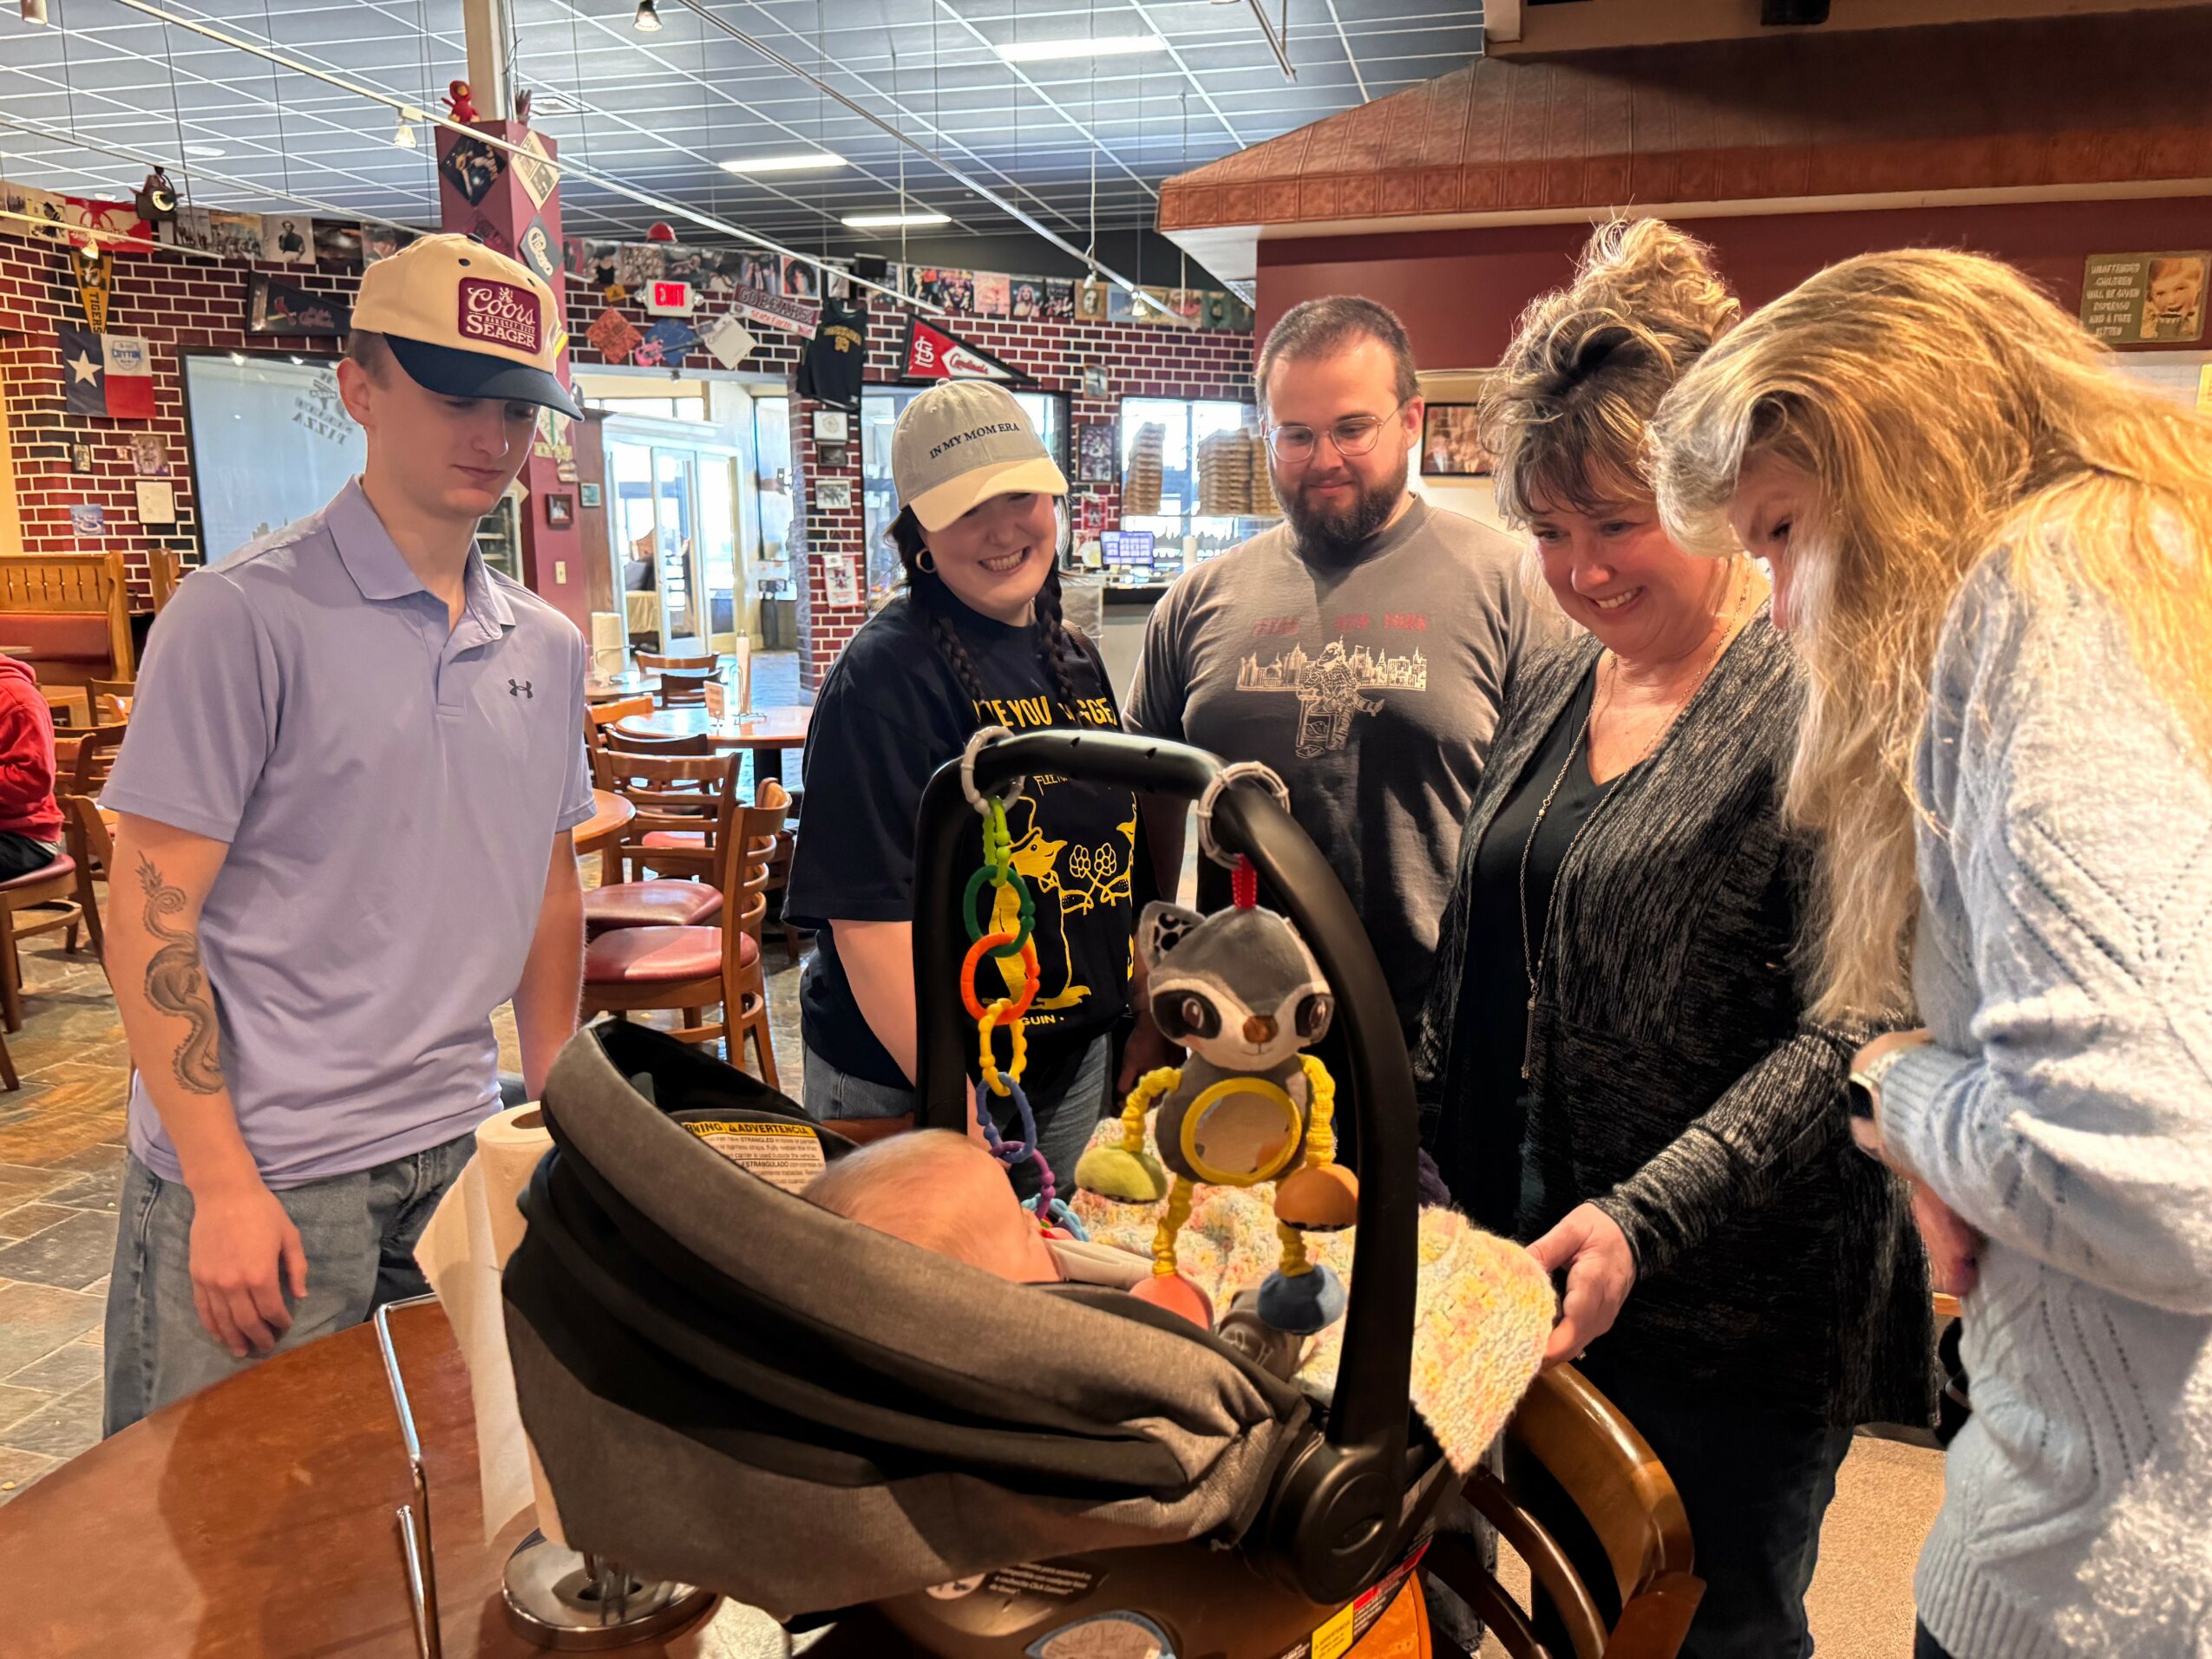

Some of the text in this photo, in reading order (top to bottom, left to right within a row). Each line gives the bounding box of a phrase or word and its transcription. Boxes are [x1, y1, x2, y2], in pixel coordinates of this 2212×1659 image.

[655, 283, 685, 306] EXIT
[2095, 276, 2133, 286] CHILDREN
[89, 291, 102, 334] TIGERS
[468, 286, 536, 325] Coors
[467, 315, 536, 349] SEAGER
[929, 422, 1020, 459] IN MY MOM ERA
[1006, 696, 1052, 728] YOU
[1022, 1015, 1056, 1025] GUIN
[737, 1123, 809, 1134] ADVERTENCIA
